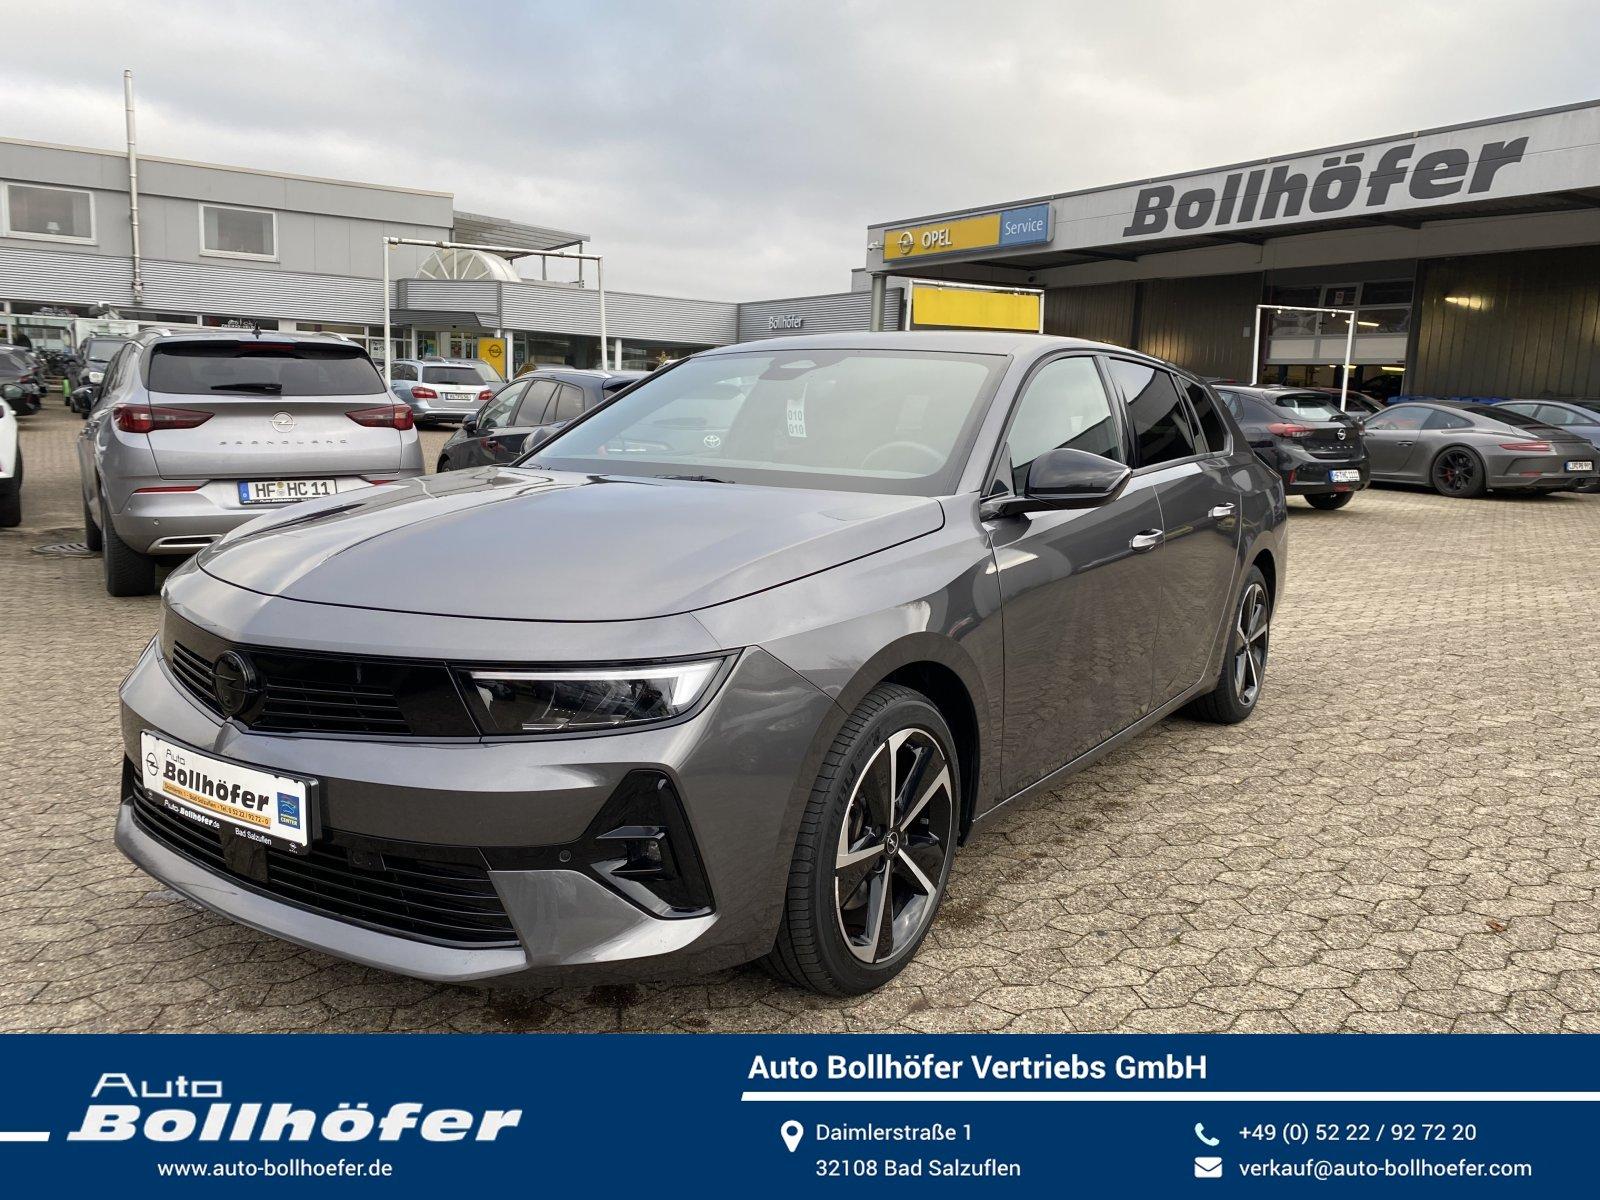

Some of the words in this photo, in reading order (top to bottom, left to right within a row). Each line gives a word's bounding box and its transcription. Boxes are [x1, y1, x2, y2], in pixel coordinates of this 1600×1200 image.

[1122, 136, 1529, 237] Bollhöfer
[1005, 219, 1043, 236] Service
[921, 229, 952, 249] OPEL
[768, 315, 802, 329] Bollhöfer
[788, 409, 803, 421] 010
[254, 483, 276, 498] HF
[287, 482, 308, 497] HC
[311, 481, 330, 496] 11
[165, 748, 186, 766] Auto
[163, 760, 270, 812] Bollhöfer
[234, 827, 247, 838] Bad
[246, 830, 272, 846] Salzuflen
